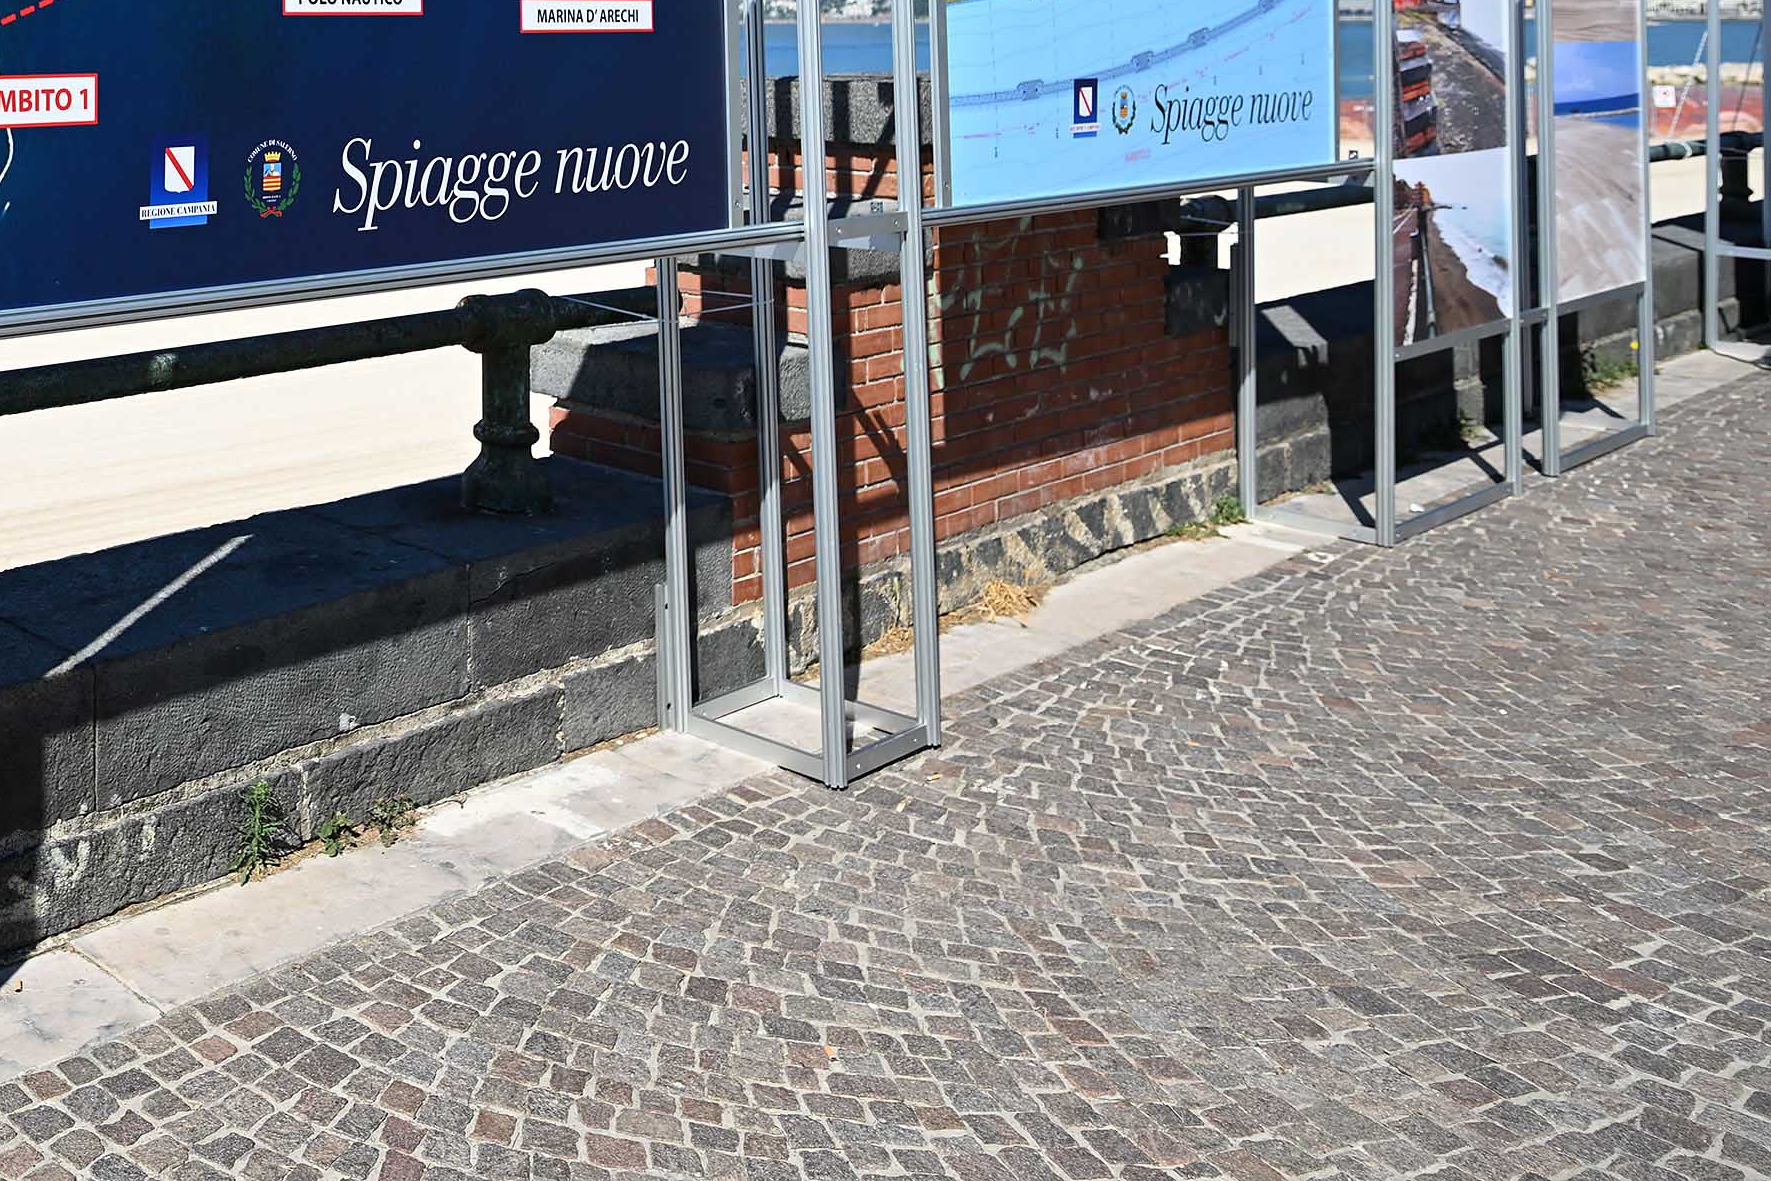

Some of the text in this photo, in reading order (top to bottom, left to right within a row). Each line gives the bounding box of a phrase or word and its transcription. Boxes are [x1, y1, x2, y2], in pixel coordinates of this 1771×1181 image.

[537, 8, 584, 24] MARINA
[79, 88, 88, 110] 1
[1150, 83, 1314, 145] Spiagge nuove
[247, 140, 269, 163] COMUNE
[333, 137, 690, 232] Spiagge nuove
[141, 203, 216, 218] REGIONE CAMPANIA
